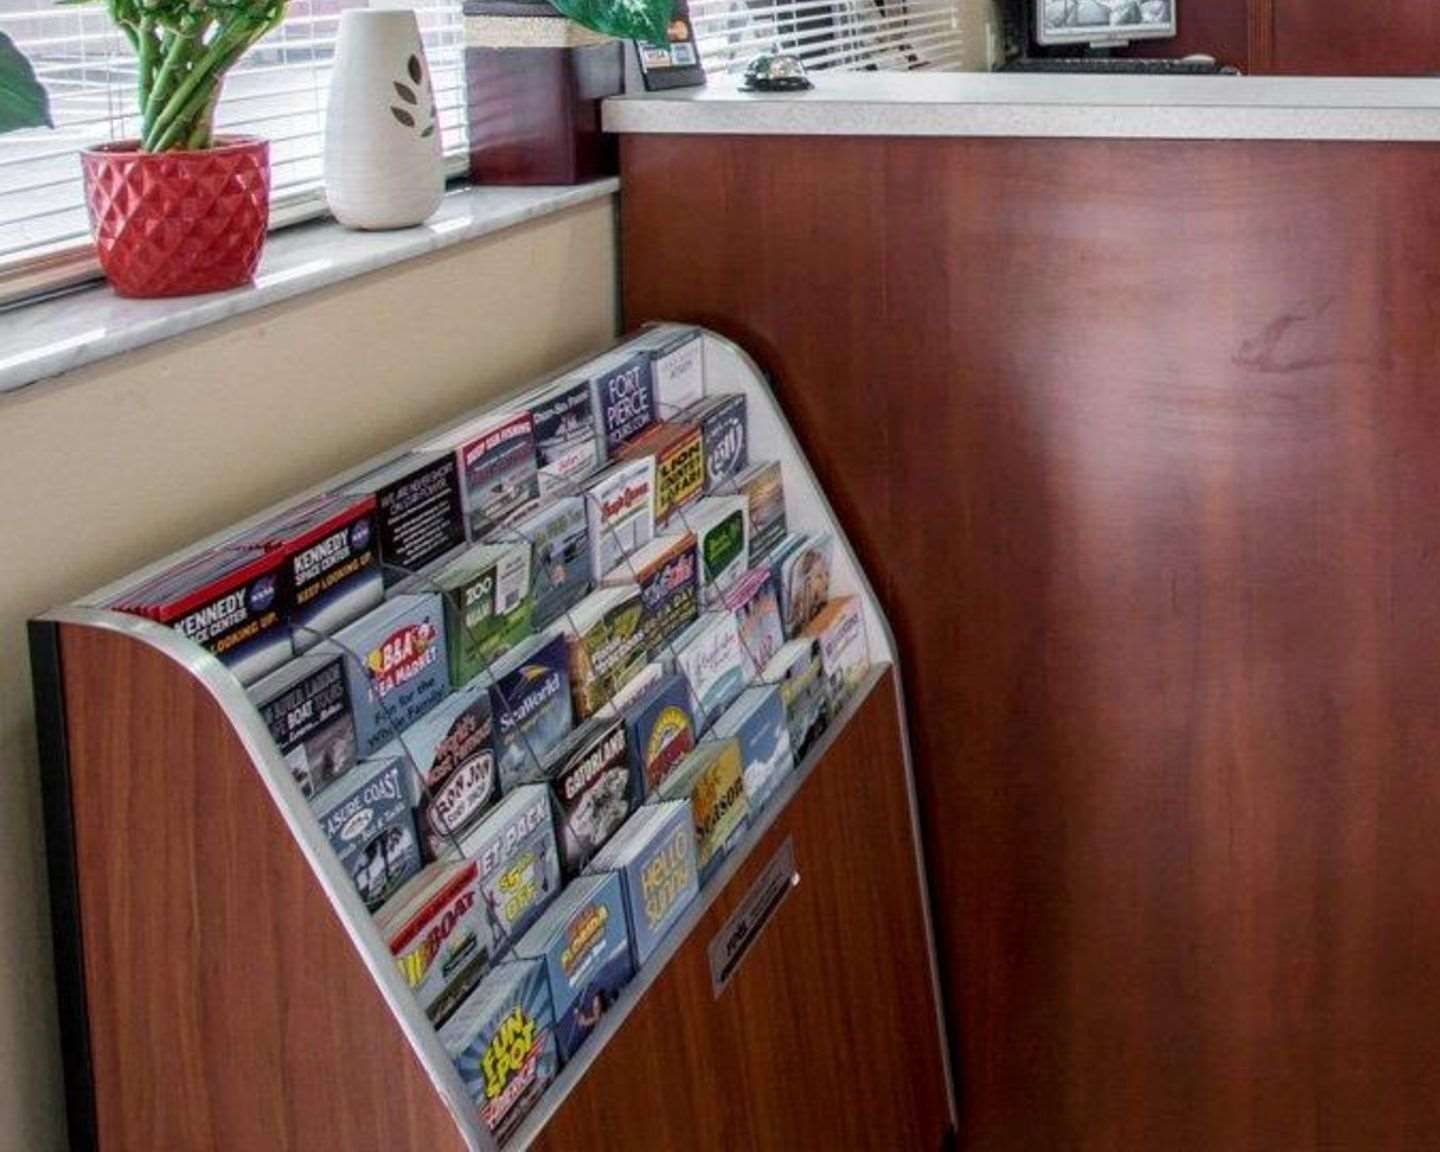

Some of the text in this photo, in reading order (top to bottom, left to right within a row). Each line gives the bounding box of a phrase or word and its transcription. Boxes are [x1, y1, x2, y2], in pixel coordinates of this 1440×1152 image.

[606, 384, 648, 432] PIERCE
[607, 364, 641, 405] FORT
[661, 441, 701, 477] LION
[293, 528, 350, 574] KENNEDY
[295, 543, 350, 588] SPACE CENTER
[297, 579, 320, 605] KEEP
[321, 556, 359, 590] LOOKING
[465, 573, 492, 608] ZOO
[174, 587, 247, 635] KENNEDY
[209, 603, 248, 639] CENTER
[399, 642, 437, 685] MARKET
[286, 697, 313, 732] BOAT
[375, 671, 435, 729] Fun for the
[500, 674, 560, 732] SeaWorld
[565, 724, 626, 800] GATORLAND
[365, 766, 402, 811] COAST
[506, 799, 547, 849] PACK
[483, 1005, 529, 1079] FUN
[486, 1015, 538, 1099] SPOT
